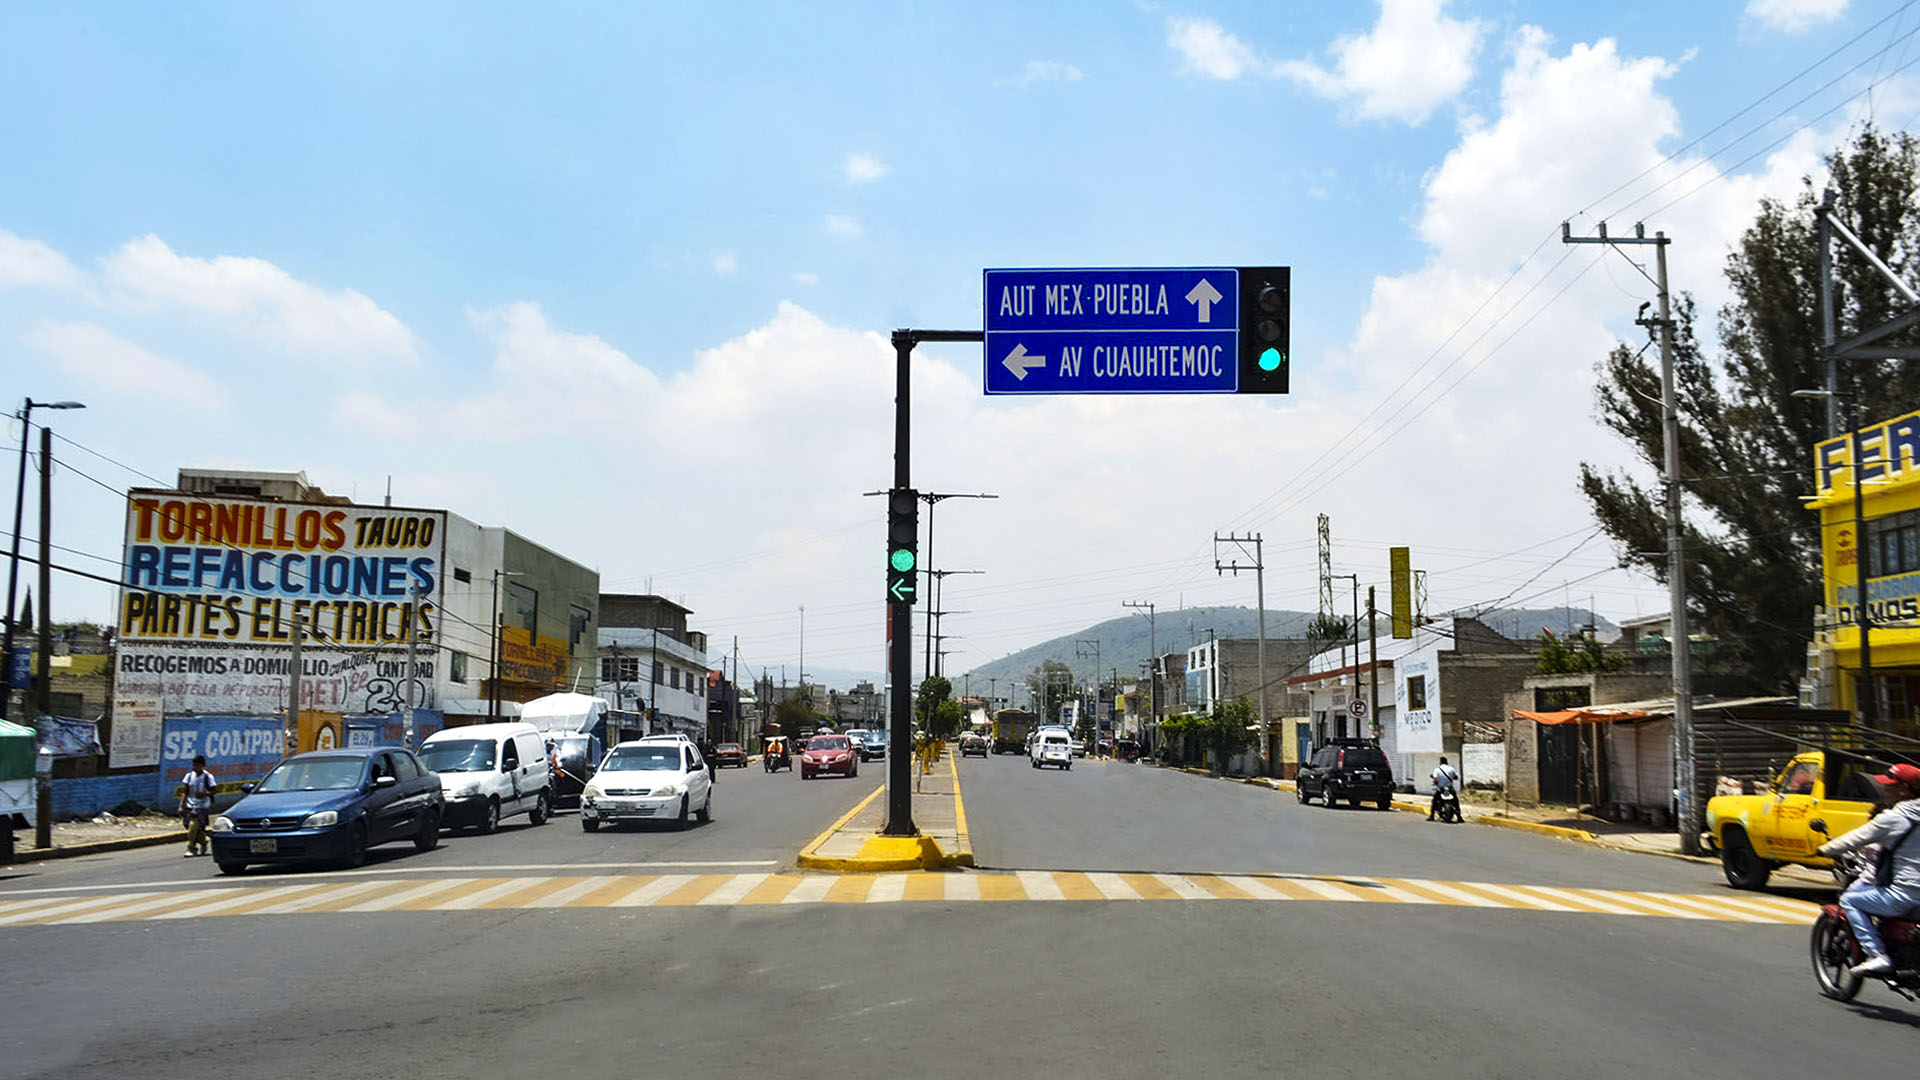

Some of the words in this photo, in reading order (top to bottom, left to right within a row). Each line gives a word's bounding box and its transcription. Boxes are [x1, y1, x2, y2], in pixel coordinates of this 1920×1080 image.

[1000, 285, 1035, 316] AUT
[1059, 346, 1082, 377] AV
[1093, 345, 1223, 377] CUAUHTEMOC
[132, 498, 347, 552] TORNILLOS
[354, 517, 436, 549] TAURO
[127, 545, 435, 599] REFACCIONES
[122, 592, 242, 639] PARTES
[250, 597, 434, 644] ELECTRICAS
[120, 654, 227, 675] RECOGEMOS
[230, 658, 240, 672] A
[244, 658, 328, 677] DOMILIO
[329, 653, 377, 676] CUALQUIER
[377, 660, 433, 678] CANTDAD
[164, 731, 198, 760] SE
[205, 729, 284, 758] COMPRA
